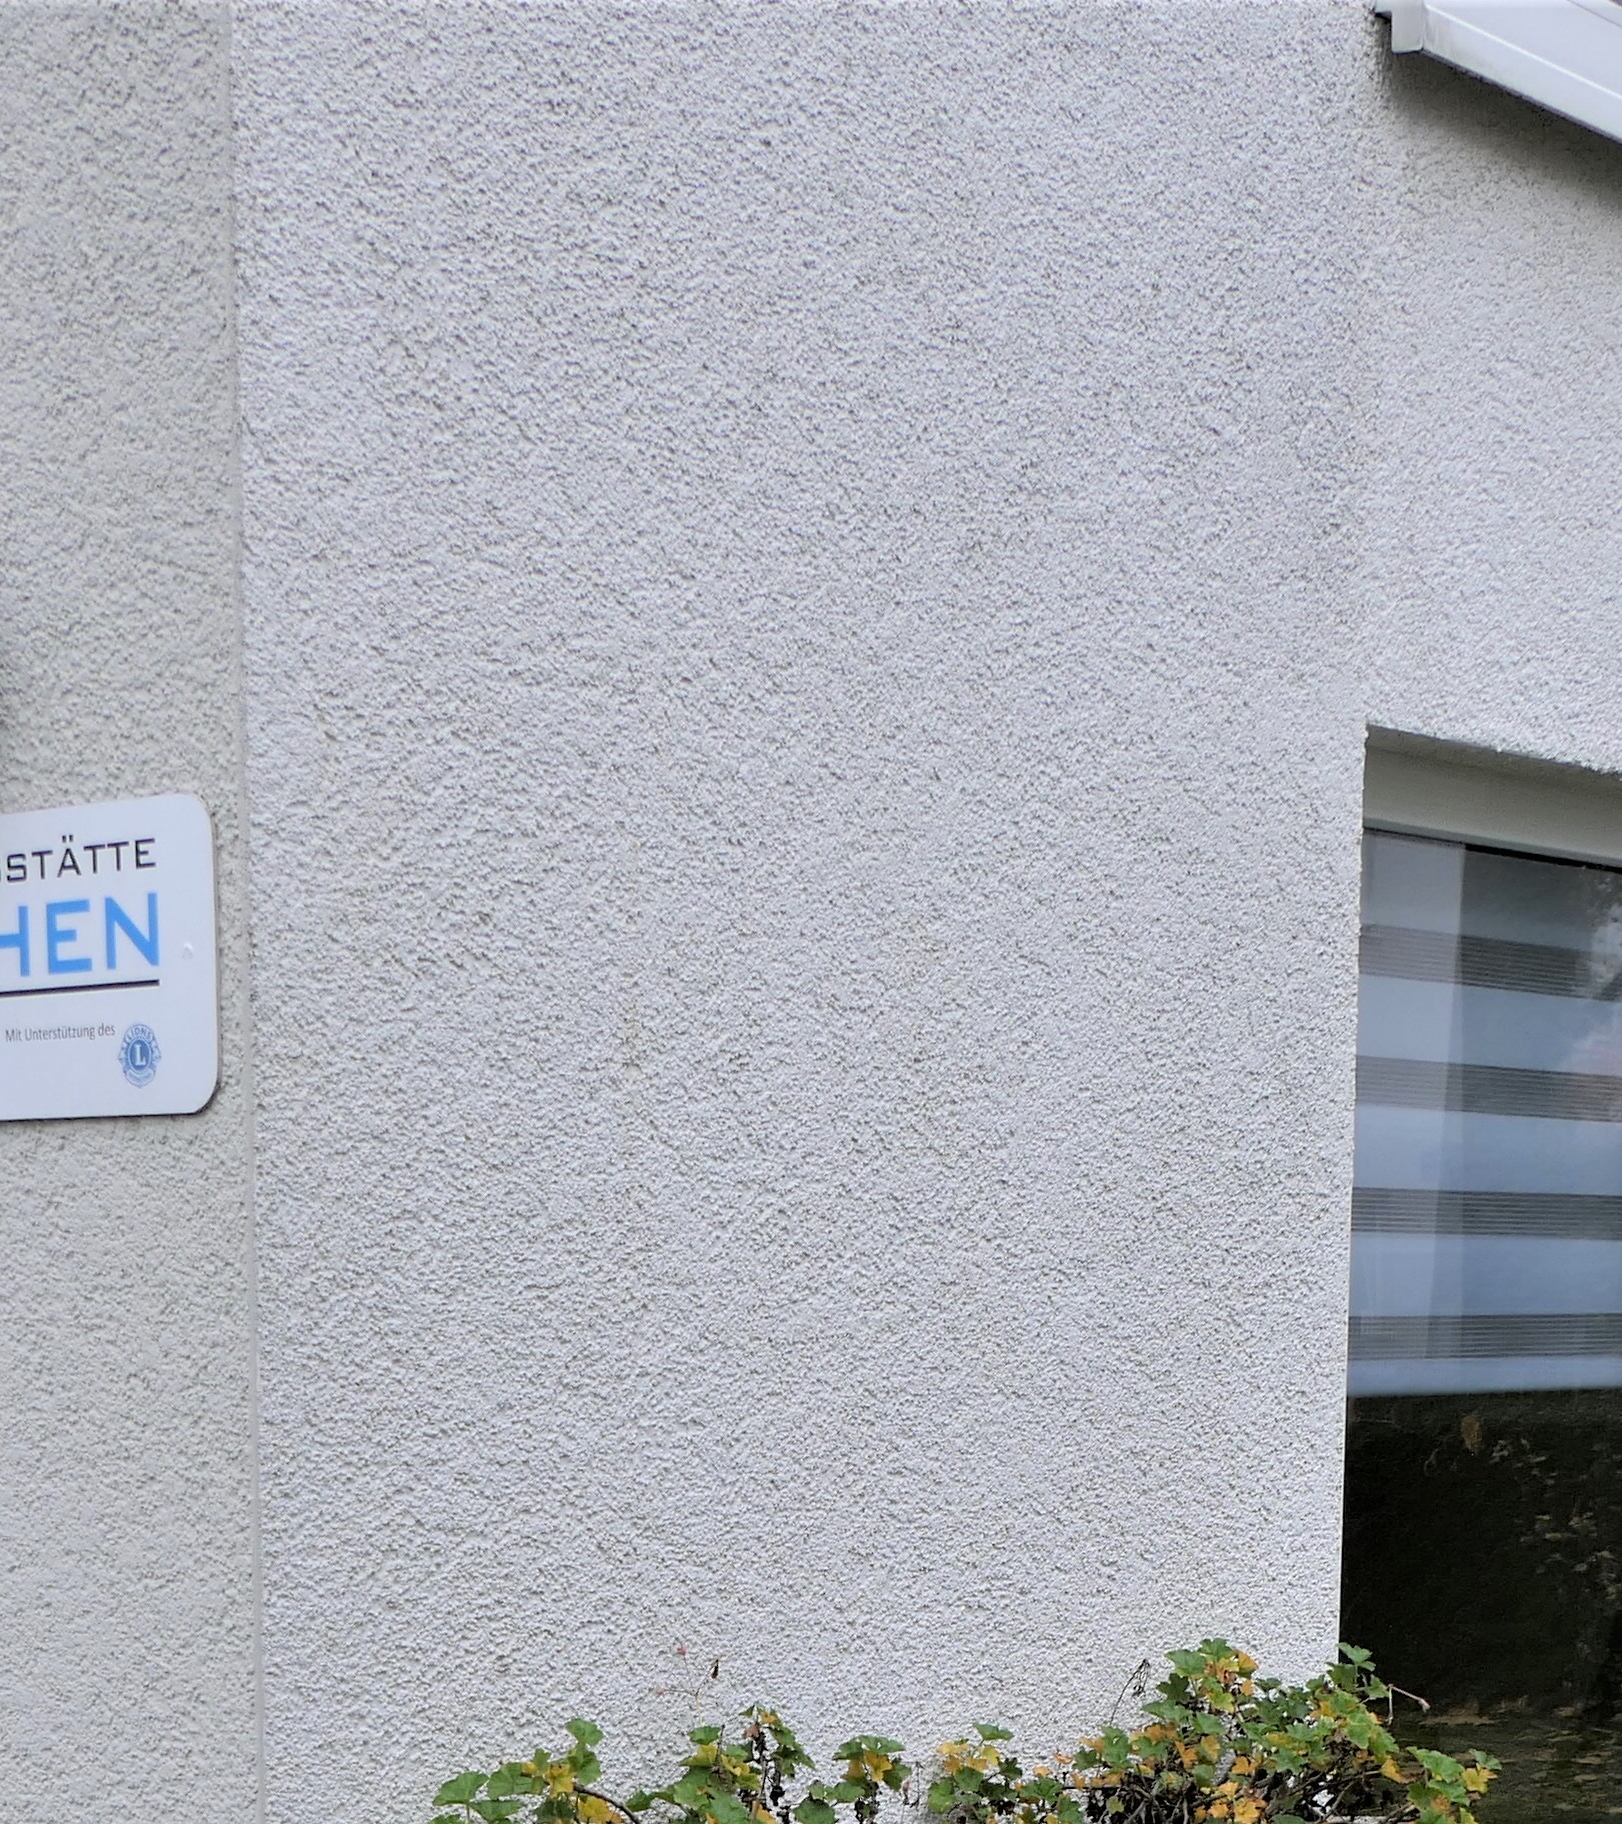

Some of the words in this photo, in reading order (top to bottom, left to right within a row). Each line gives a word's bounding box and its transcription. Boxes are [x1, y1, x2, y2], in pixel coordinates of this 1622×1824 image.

[5, 1028, 22, 1042] Mit
[25, 1025, 96, 1041] Unterstützung
[97, 1022, 116, 1038] des
[133, 1043, 147, 1066] L
